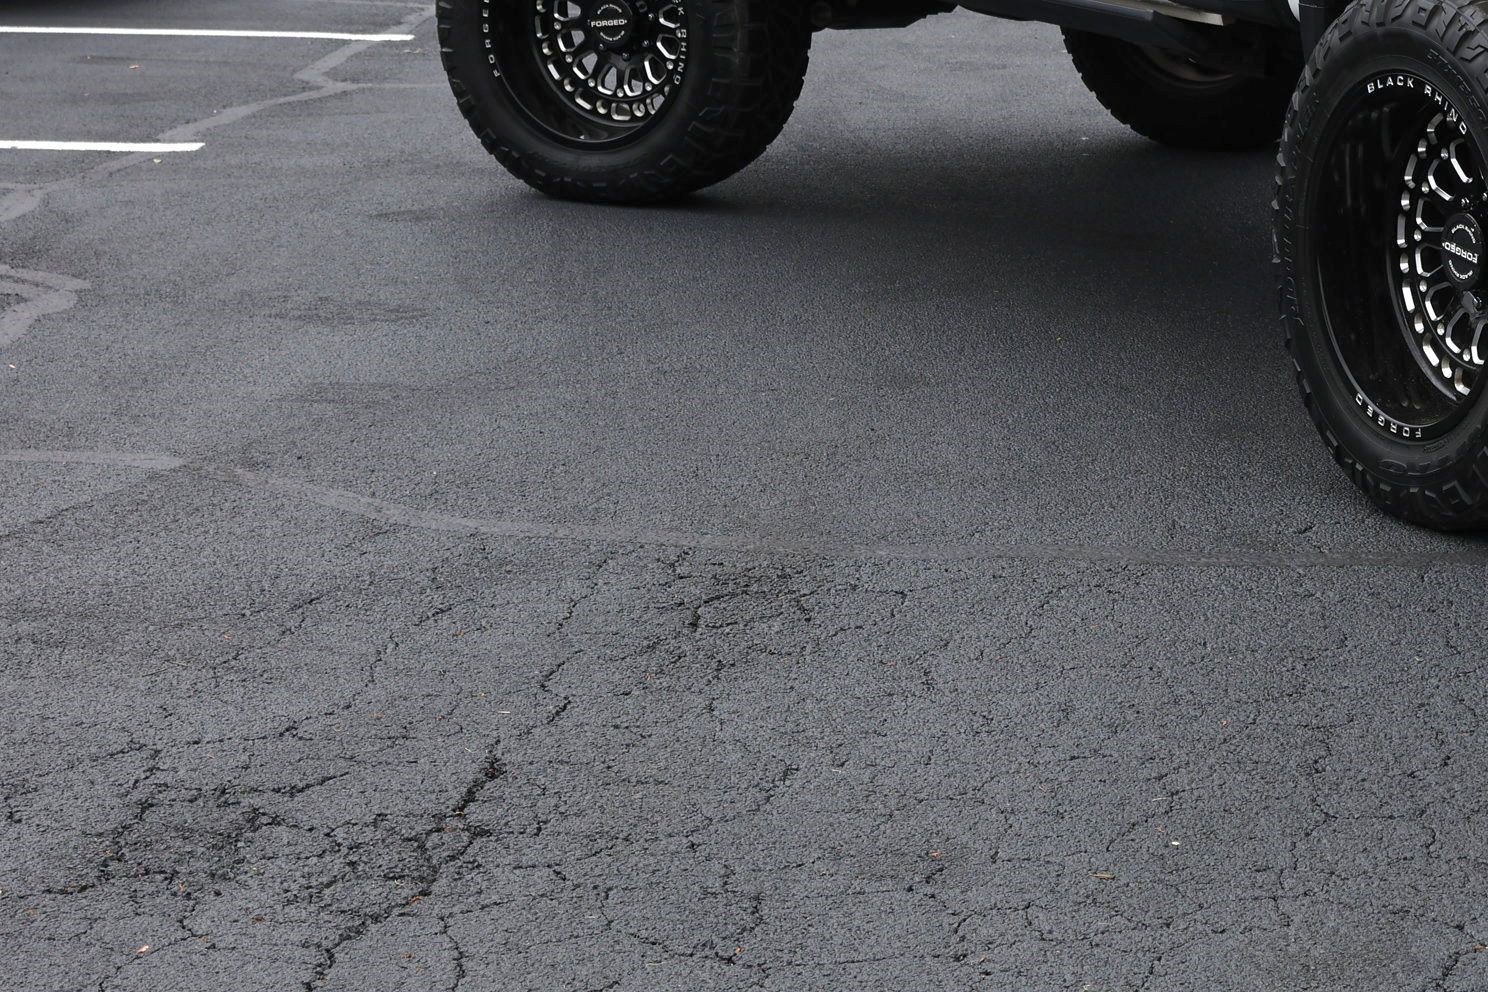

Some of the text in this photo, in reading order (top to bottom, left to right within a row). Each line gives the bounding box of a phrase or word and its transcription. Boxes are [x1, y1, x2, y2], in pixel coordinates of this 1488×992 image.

[591, 19, 625, 27] FORGED
[1366, 74, 1416, 94] BLACK
[1423, 84, 1468, 136] RHINO
[1444, 242, 1479, 264] FORGED
[1354, 392, 1422, 438] FORGED
